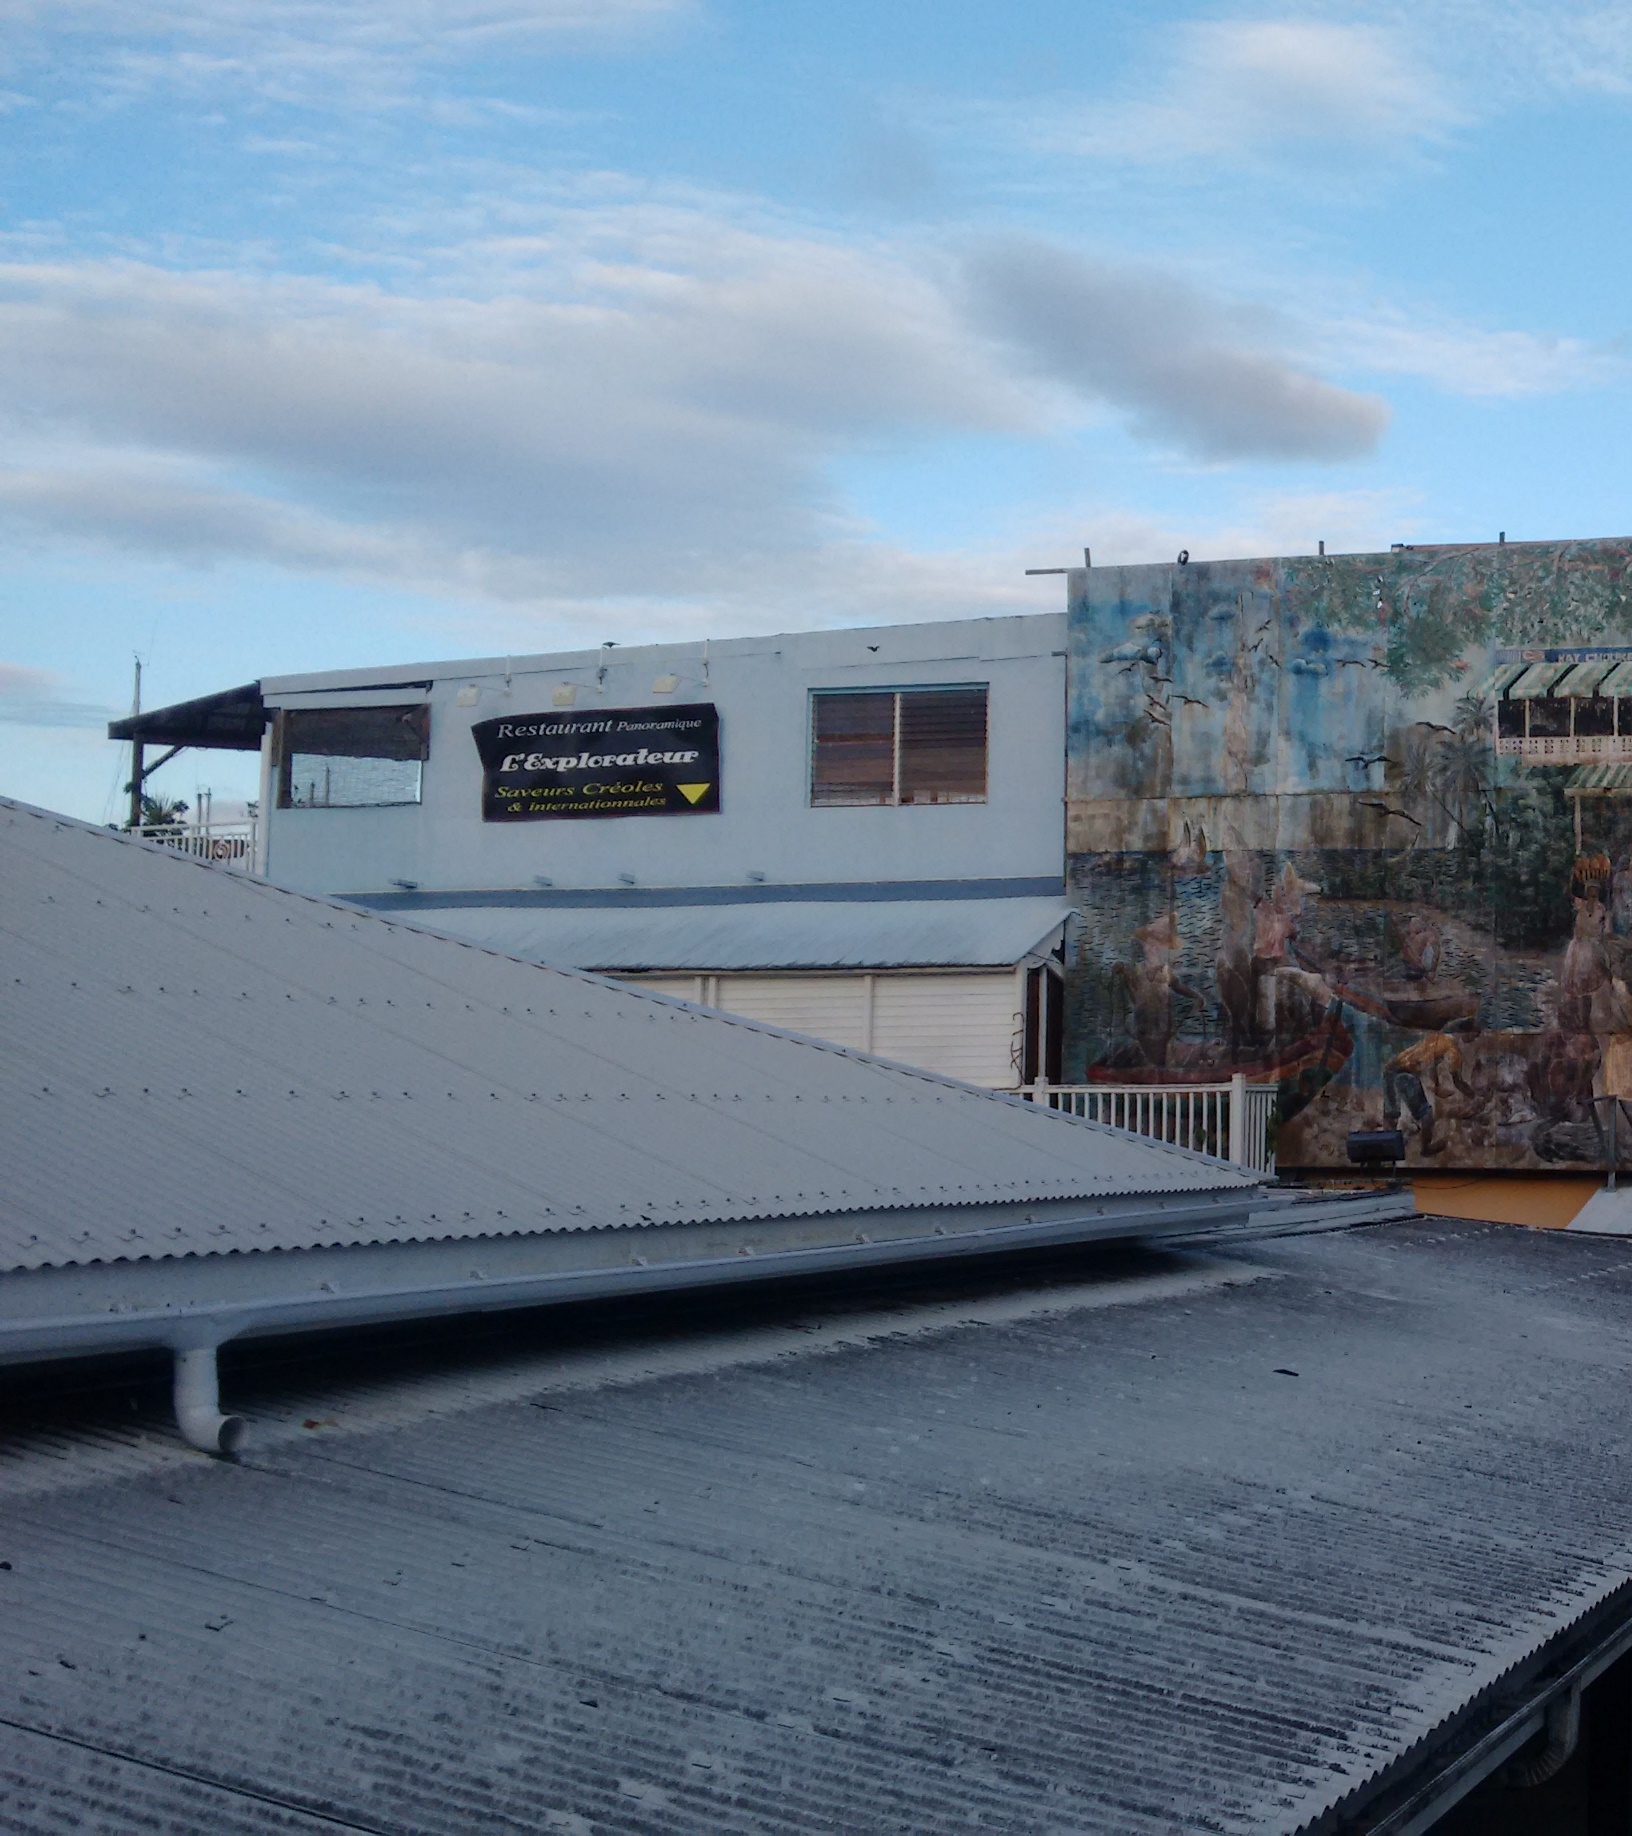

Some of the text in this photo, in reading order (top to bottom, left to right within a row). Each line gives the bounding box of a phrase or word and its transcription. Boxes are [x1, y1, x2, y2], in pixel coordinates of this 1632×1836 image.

[497, 719, 702, 739] Restaurant Panoramique
[500, 749, 698, 772] L'Explorateur
[495, 781, 664, 799] Saveurs Créoles
[507, 796, 666, 813] & internationnales
